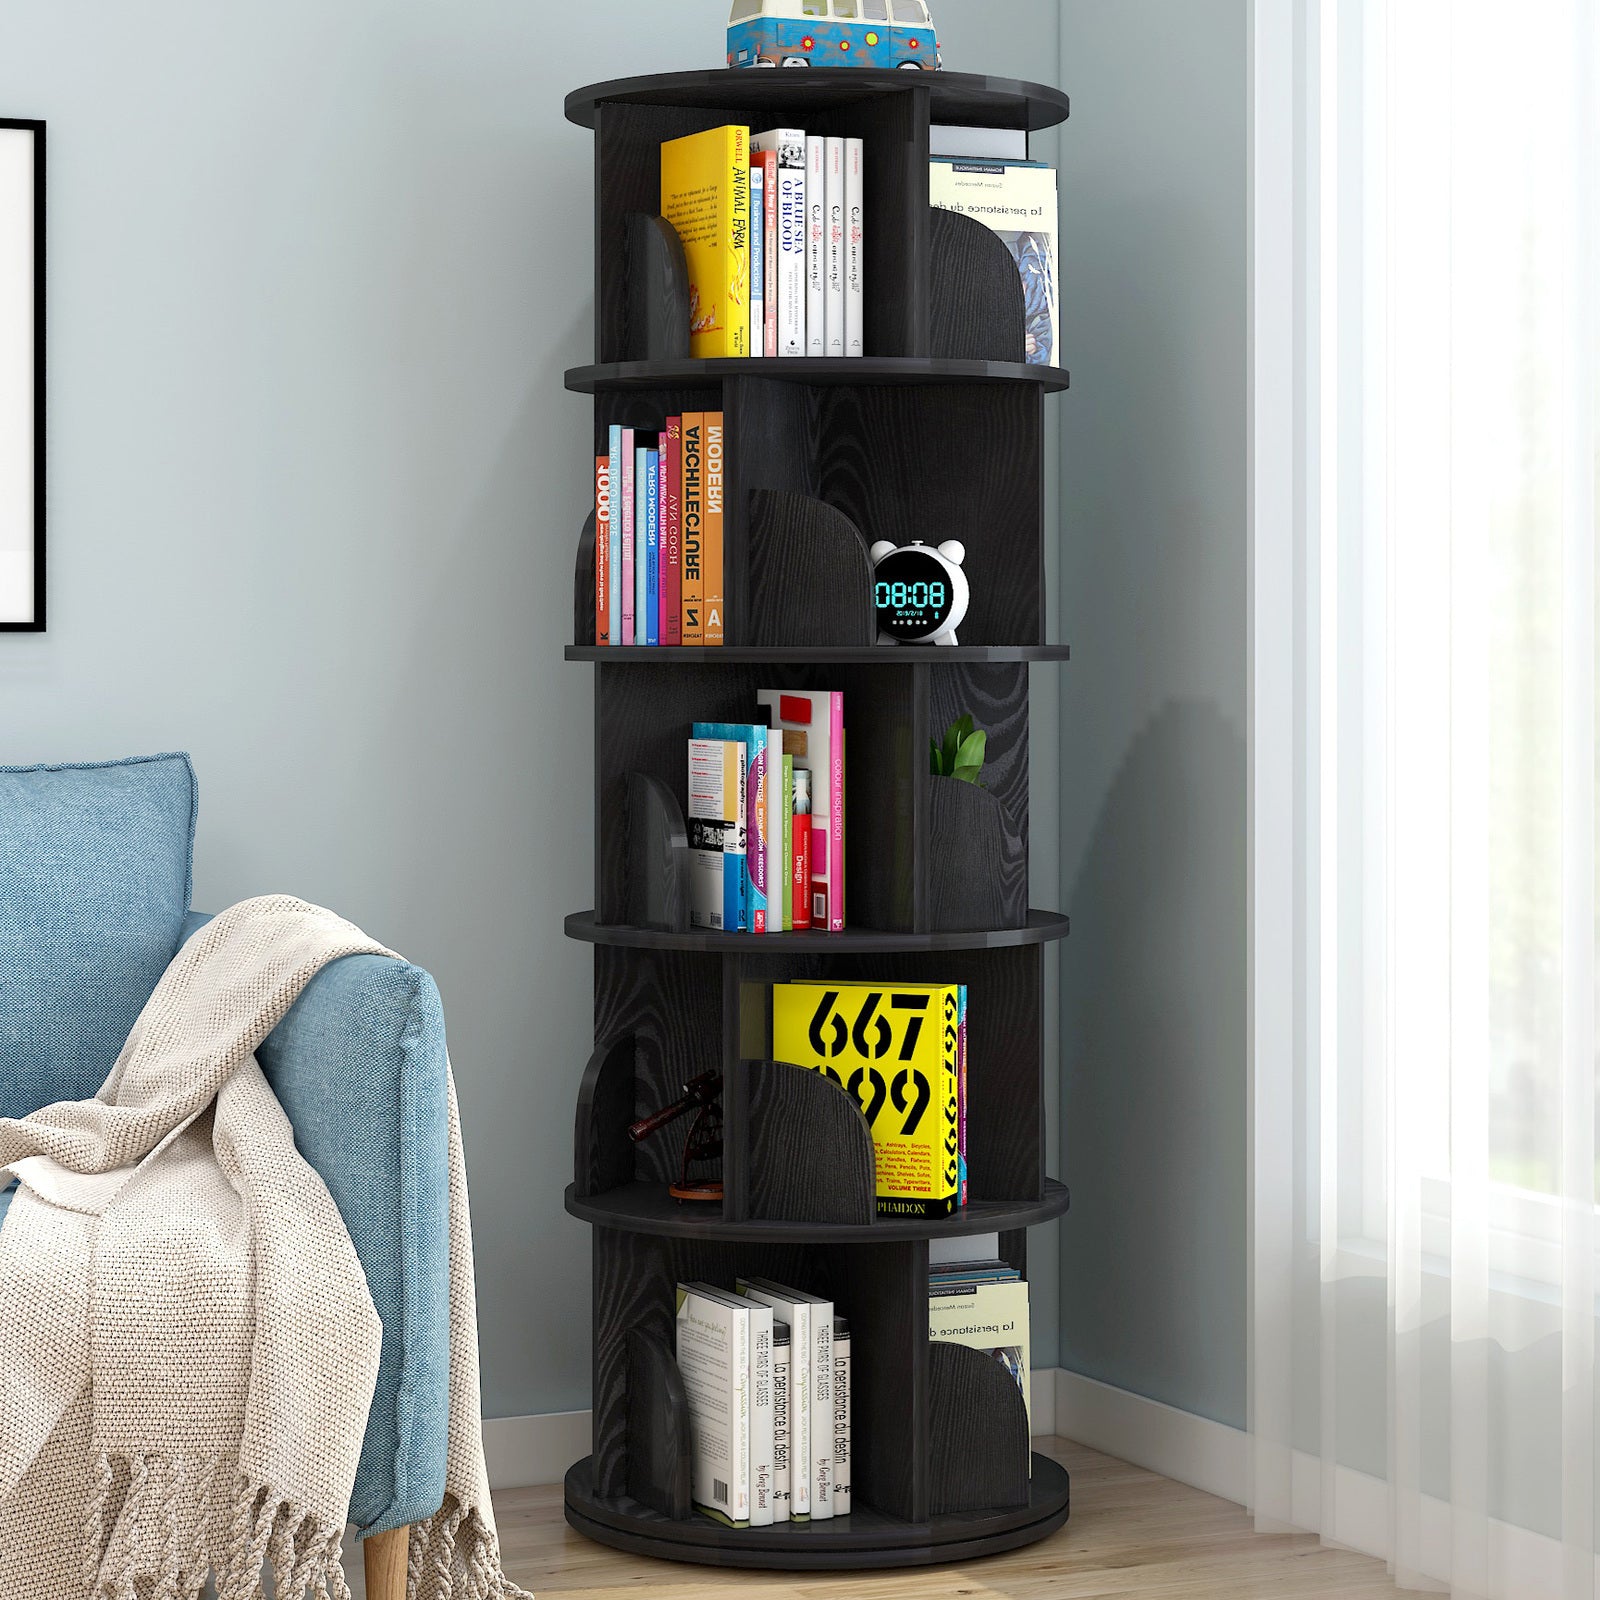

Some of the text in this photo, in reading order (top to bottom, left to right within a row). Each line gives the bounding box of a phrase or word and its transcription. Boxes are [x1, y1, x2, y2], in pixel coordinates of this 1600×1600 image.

[732, 129, 746, 250] ORWELL ANIMAL FARM
[782, 180, 792, 252] OF BLOOD
[794, 178, 803, 254] A BLUE SEA
[752, 200, 760, 287] Business and Production
[876, 582, 944, 608] 08:08
[834, 792, 842, 841] inspiration
[808, 991, 930, 1061] 667
[810, 1065, 931, 1136] 99
[944, 992, 957, 1188] 667-999
[878, 1201, 925, 1214] PHAIDON
[756, 1330, 768, 1407] THREE PAIRS OF GLASSES
[817, 1325, 829, 1401] THREE PAIRS OF GLASSES
[834, 1356, 850, 1367] La
[773, 1362, 791, 1470] La persistance du destin
[834, 1370, 850, 1420] persistance
[834, 1422, 850, 1434] du
[834, 1438, 850, 1464] destin
[756, 1474, 768, 1488] Greg
[816, 1458, 830, 1466] by
[816, 1467, 830, 1481] Greg
